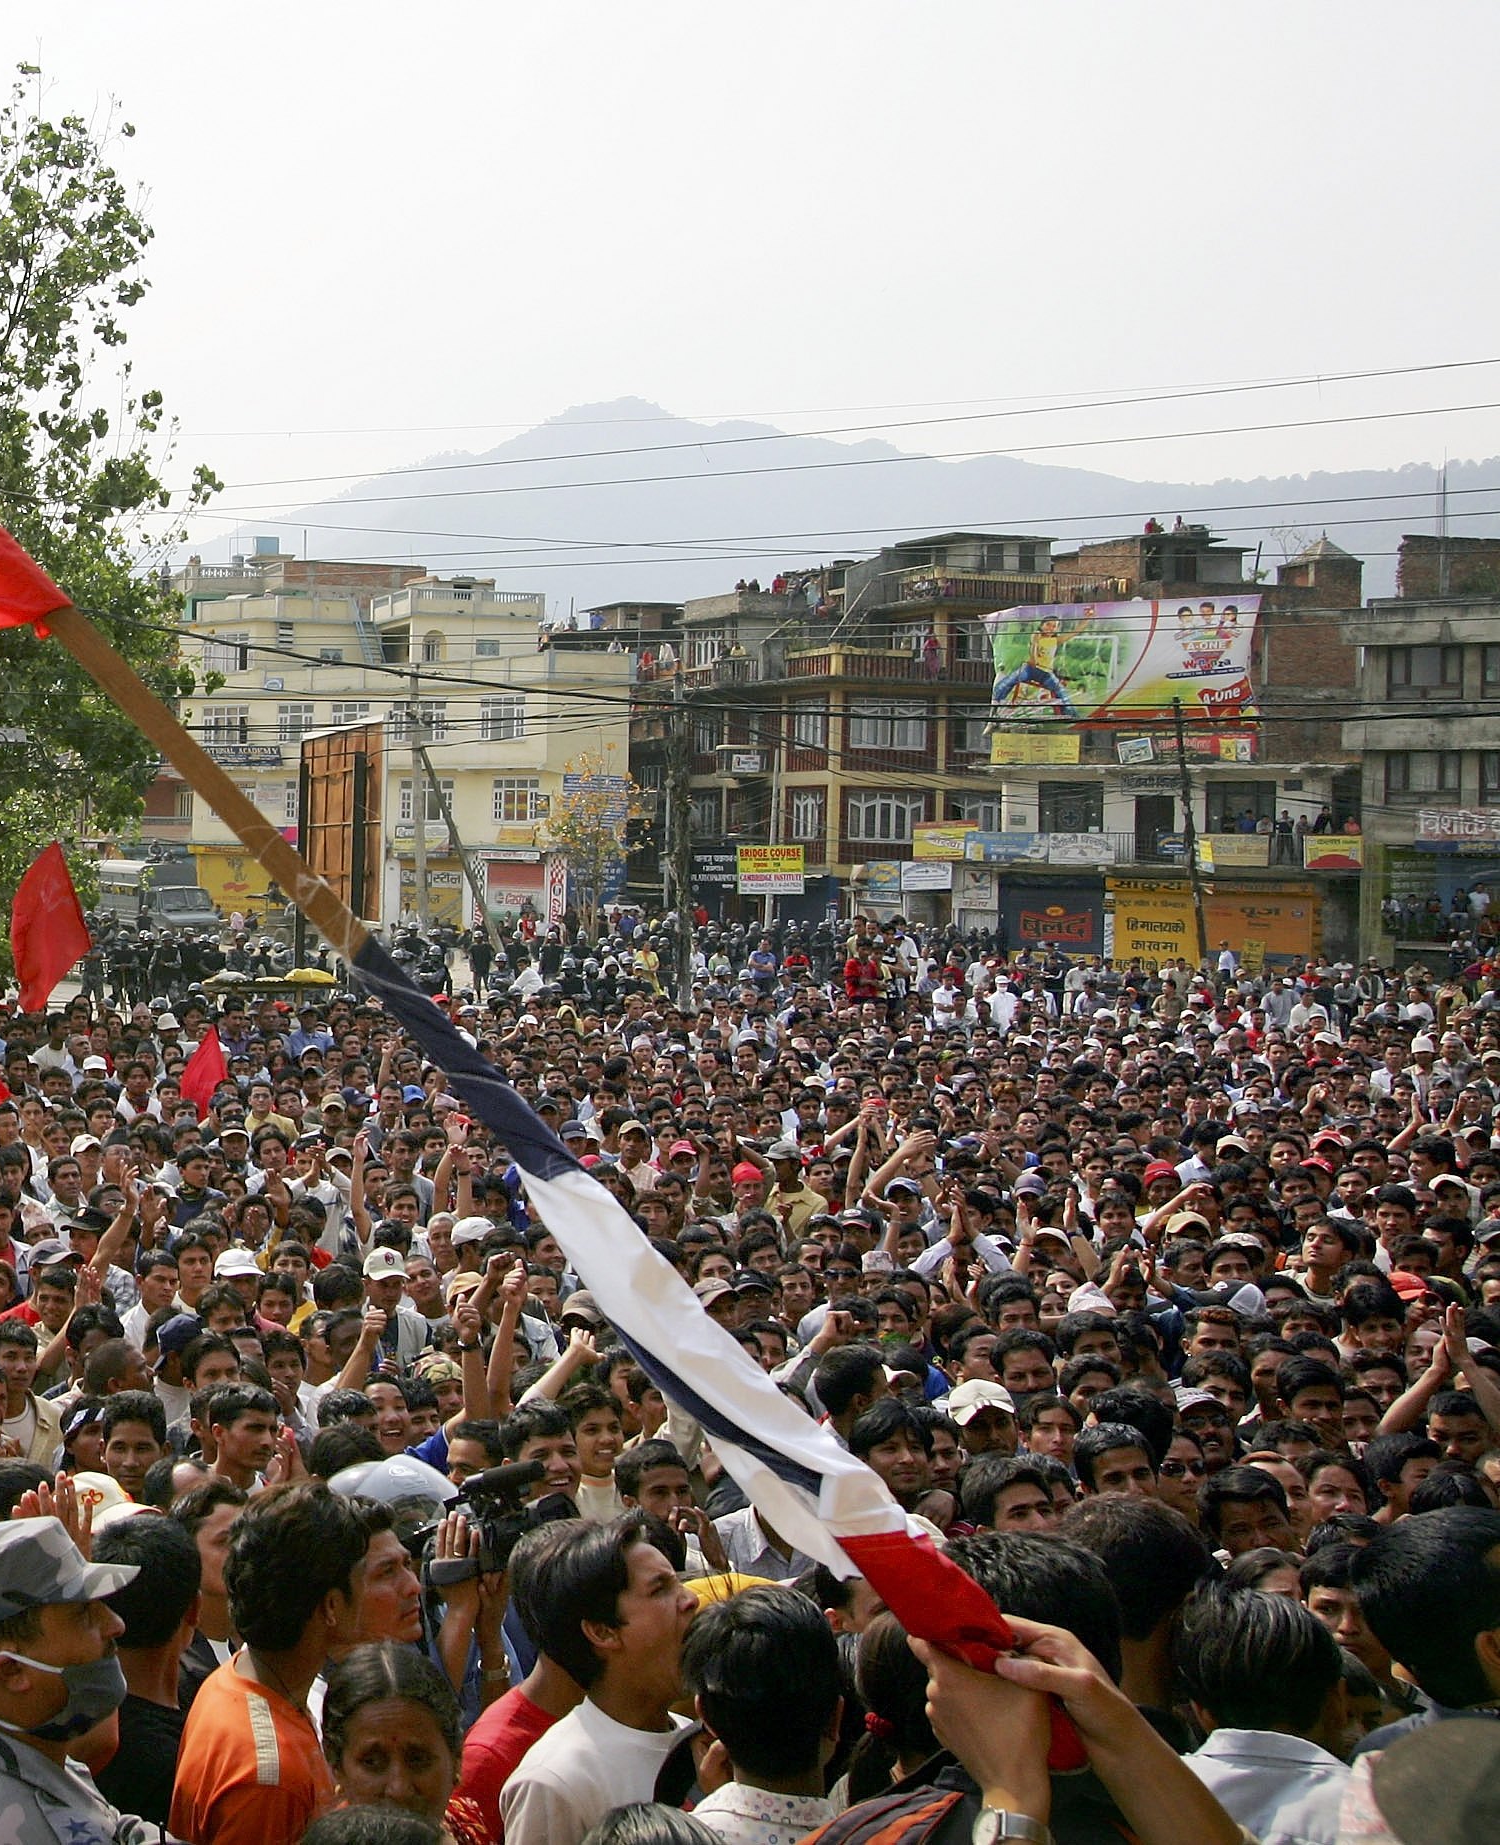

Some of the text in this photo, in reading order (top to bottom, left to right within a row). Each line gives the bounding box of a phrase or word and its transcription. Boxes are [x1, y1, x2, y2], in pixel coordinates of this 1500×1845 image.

[1202, 687, 1241, 705] A-One
[238, 746, 278, 755] ACADEMY
[739, 848, 801, 857] BRIDGE COURSE
[774, 874, 802, 882] INSTITUTE
